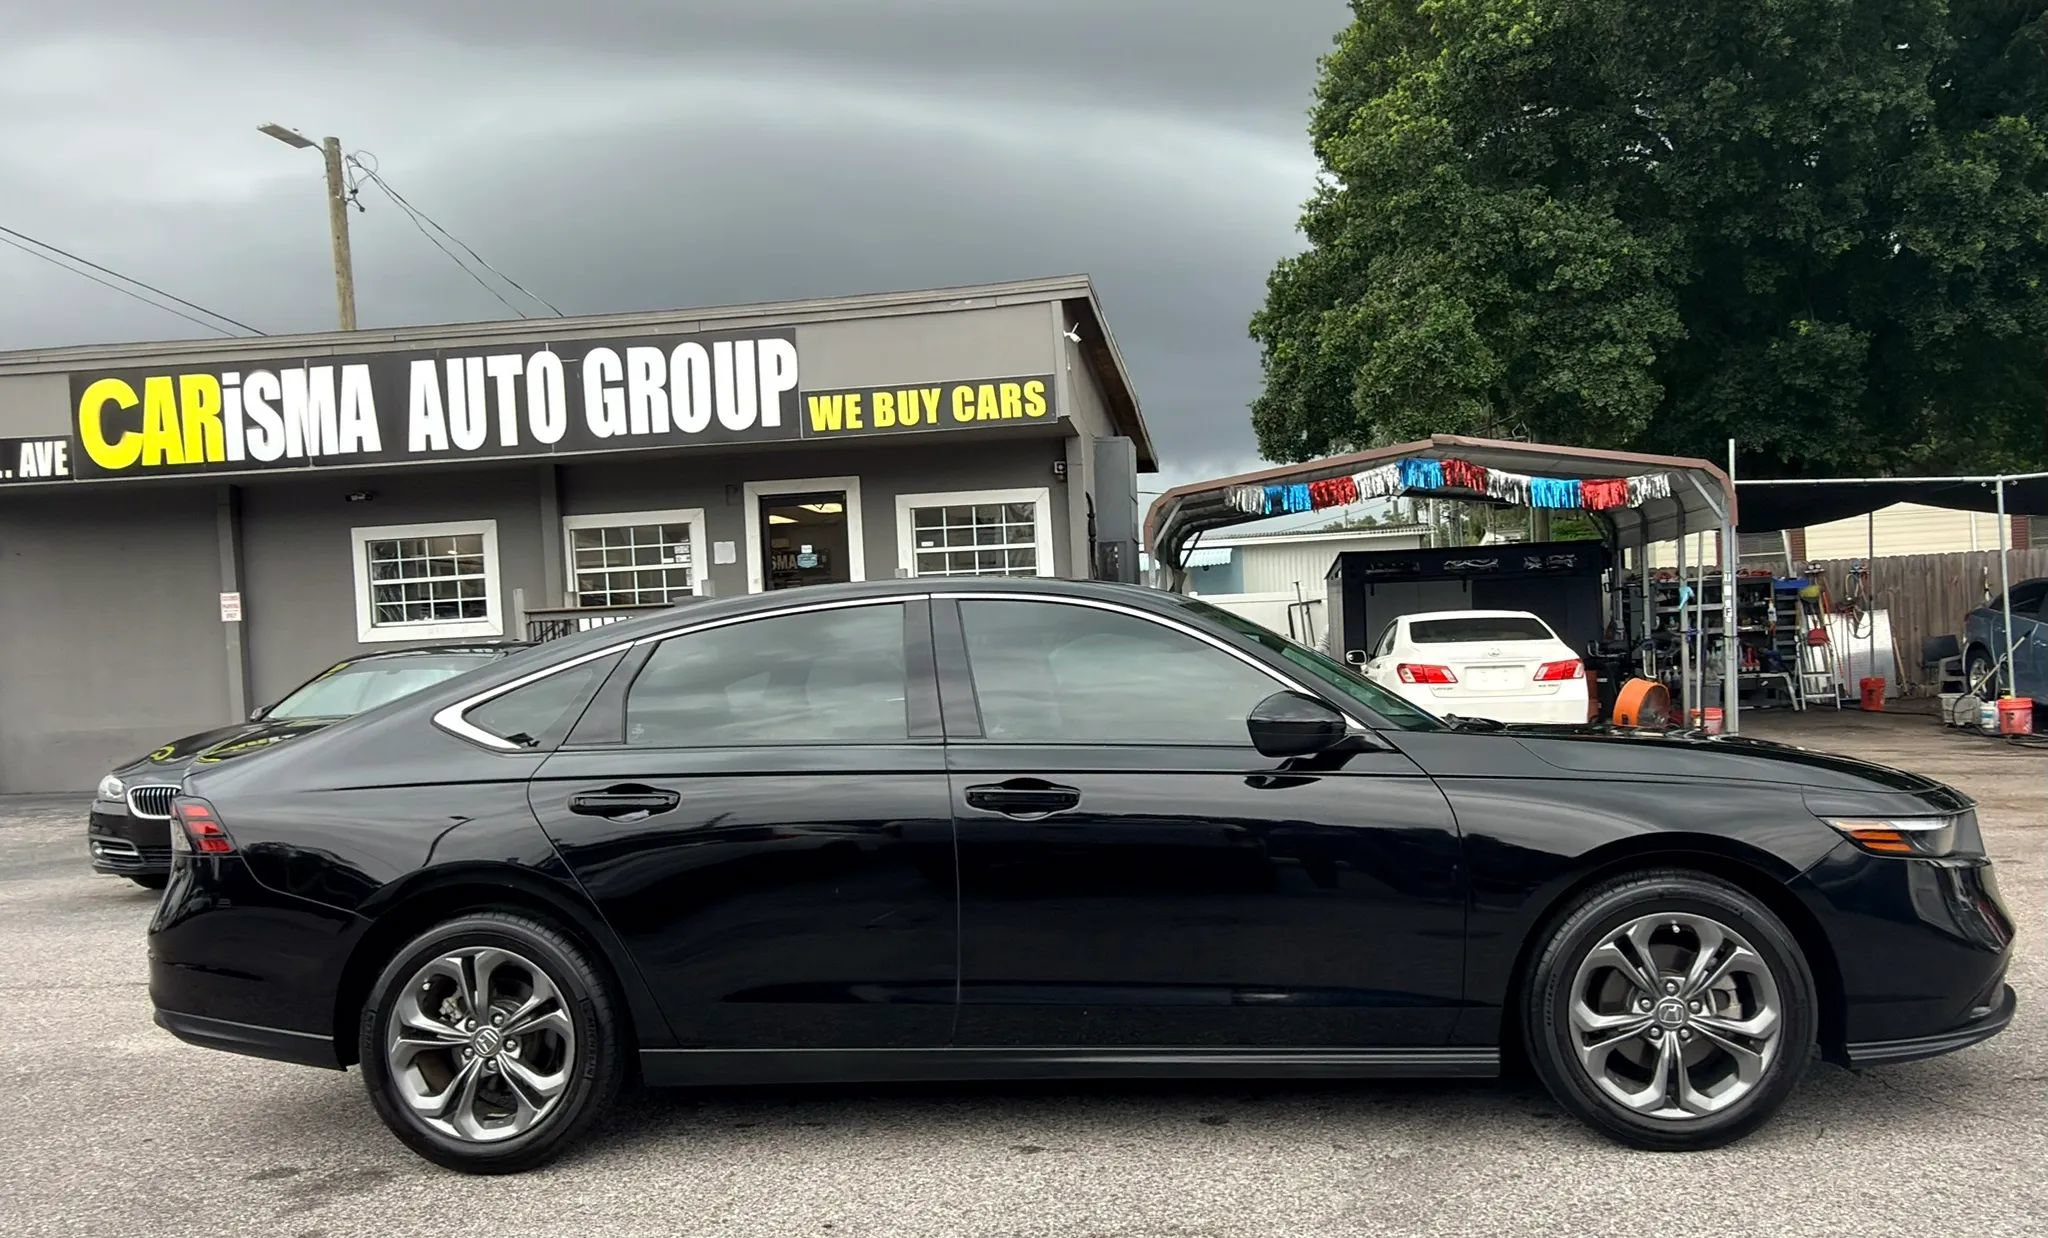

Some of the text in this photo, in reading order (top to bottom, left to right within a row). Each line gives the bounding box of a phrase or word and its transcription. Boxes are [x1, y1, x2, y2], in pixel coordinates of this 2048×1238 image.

[78, 337, 799, 471] CARiSMA AUTO GROUP
[807, 380, 1047, 432] WE BUY CARS
[19, 440, 69, 478] AVE
